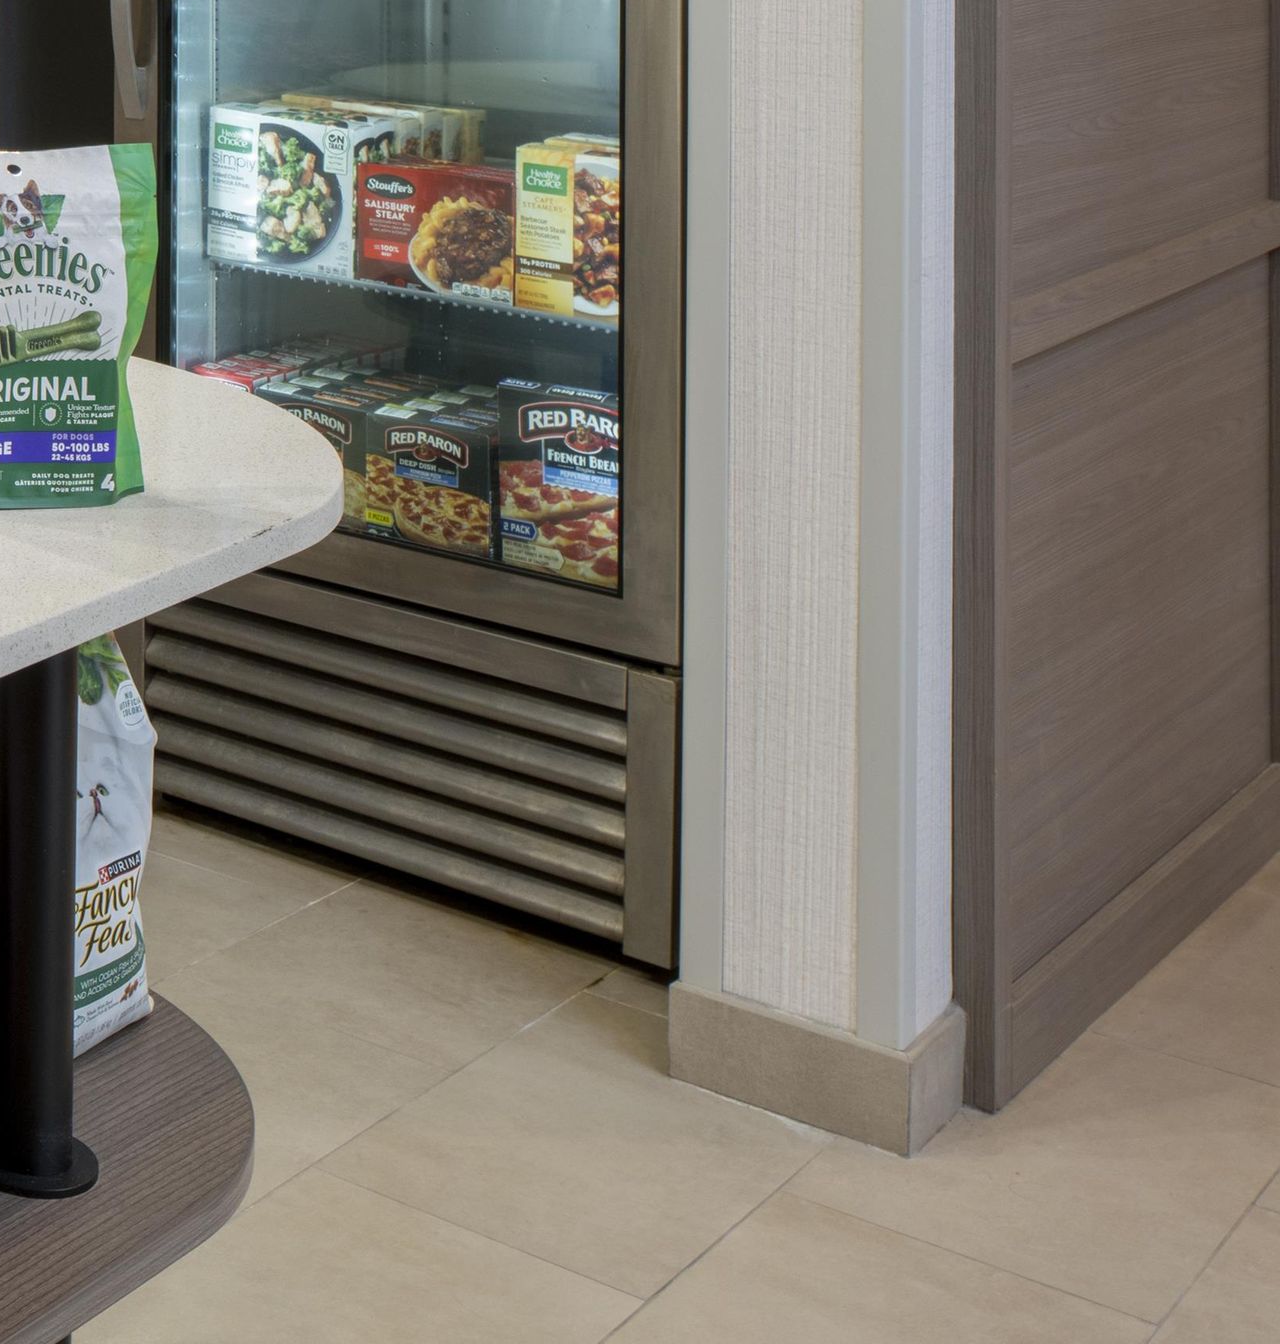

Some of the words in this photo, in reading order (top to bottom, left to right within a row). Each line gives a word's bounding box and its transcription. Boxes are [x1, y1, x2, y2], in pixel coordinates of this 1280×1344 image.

[530, 168, 561, 180] Healthy
[366, 176, 414, 195] Stouffer's
[525, 175, 562, 189] Choice
[364, 198, 416, 214] SALISBURY
[375, 208, 406, 222] STEAK
[380, 244, 400, 254] 100%
[37, 283, 90, 307] TREATS
[52, 433, 68, 441] FOR
[70, 433, 95, 441] DOGS
[390, 431, 416, 447] RED
[416, 429, 462, 458] BARON
[51, 442, 90, 453] 50-100
[91, 442, 111, 453] LBS
[398, 458, 418, 469] DEEP
[418, 462, 437, 473] DISH
[100, 473, 116, 493] 4
[502, 521, 509, 531] 2
[510, 522, 532, 536] PACK
[108, 853, 141, 877] PURINA
[75, 868, 141, 932] Fancy
